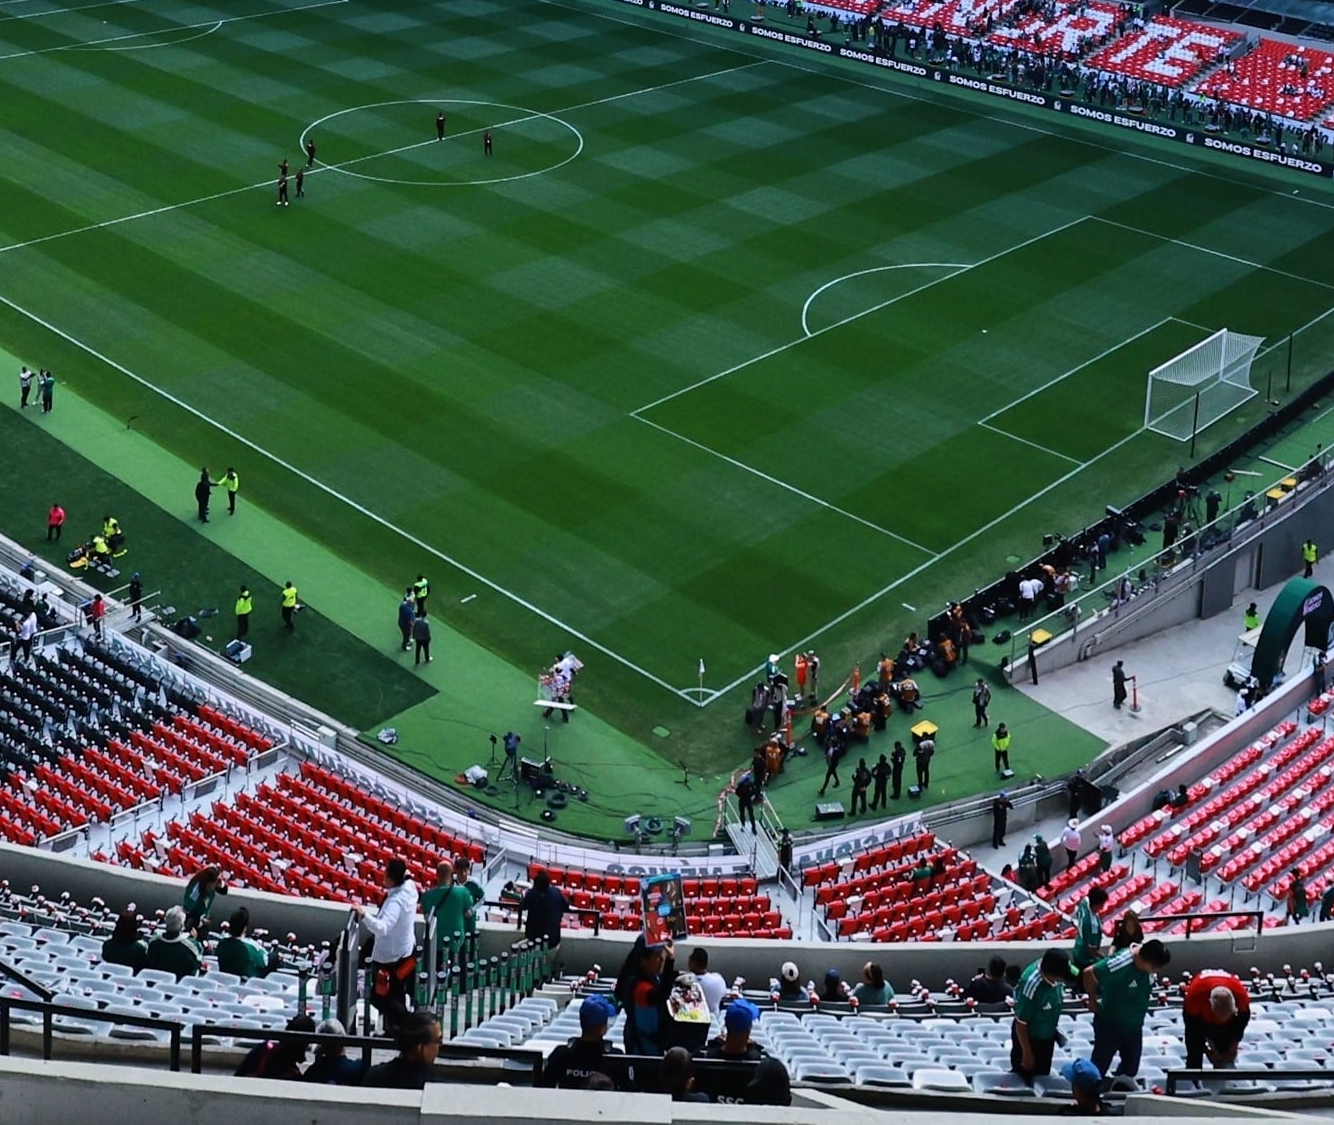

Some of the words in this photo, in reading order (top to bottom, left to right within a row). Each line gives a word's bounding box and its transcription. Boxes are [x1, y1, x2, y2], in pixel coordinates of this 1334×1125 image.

[660, 4, 690, 17] SOMOS
[690, 12, 733, 28] ESFUERZO
[751, 26, 784, 41] SOMOS
[785, 35, 832, 52] ESFUERZO
[839, 48, 875, 63] SOMOS
[875, 57, 927, 76] ESFUERZO
[949, 74, 988, 92] SOMOS
[989, 85, 1045, 106] ESFUERZO
[1070, 104, 1112, 123] SOMOS
[1113, 116, 1176, 138] ESFUERZO
[1204, 137, 1251, 156] SOMOS
[1253, 149, 1323, 173] ESFUERZO
